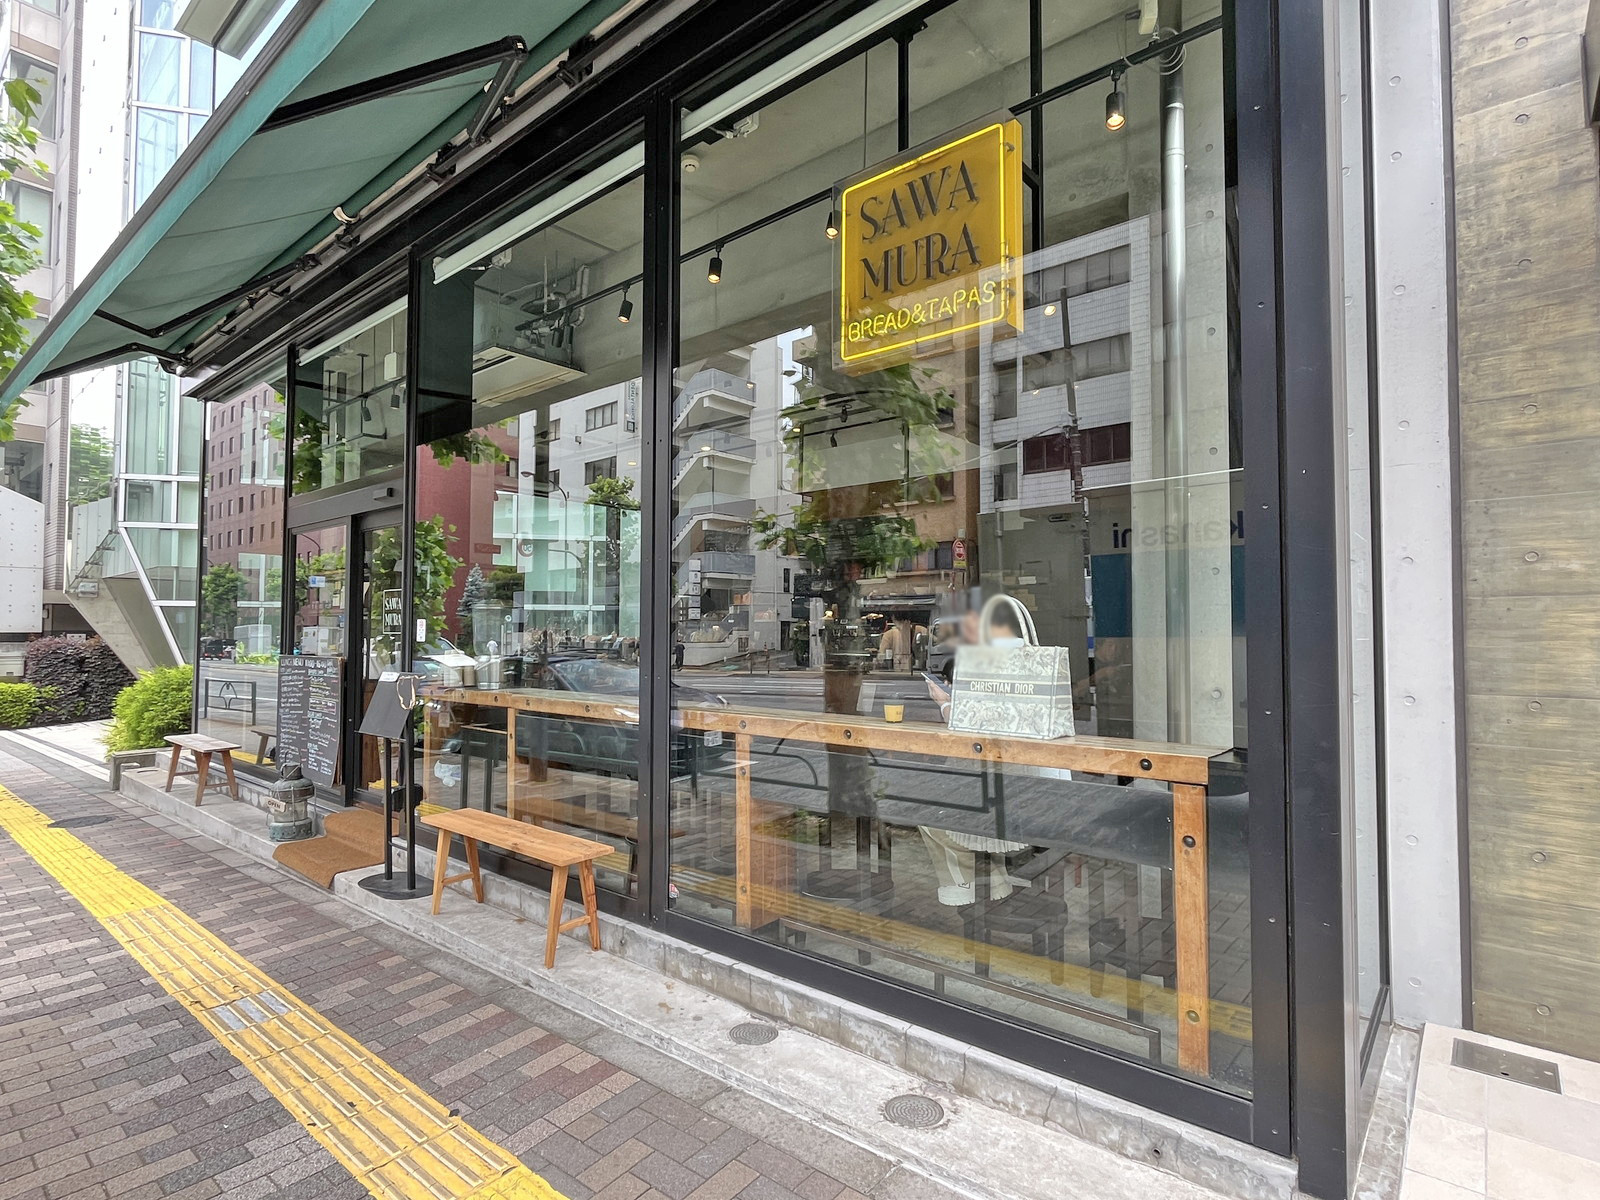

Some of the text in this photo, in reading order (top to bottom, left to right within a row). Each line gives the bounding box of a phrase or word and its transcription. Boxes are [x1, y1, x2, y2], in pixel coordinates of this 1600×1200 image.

[860, 159, 979, 241] SAWA
[860, 223, 981, 299] MURA
[848, 281, 996, 342] BREAD&TAPAS
[384, 597, 402, 610] SAWA
[384, 613, 402, 625] MURA
[970, 681, 1035, 695] CHRISTIAN DIOR
[267, 800, 281, 809] OPEN
